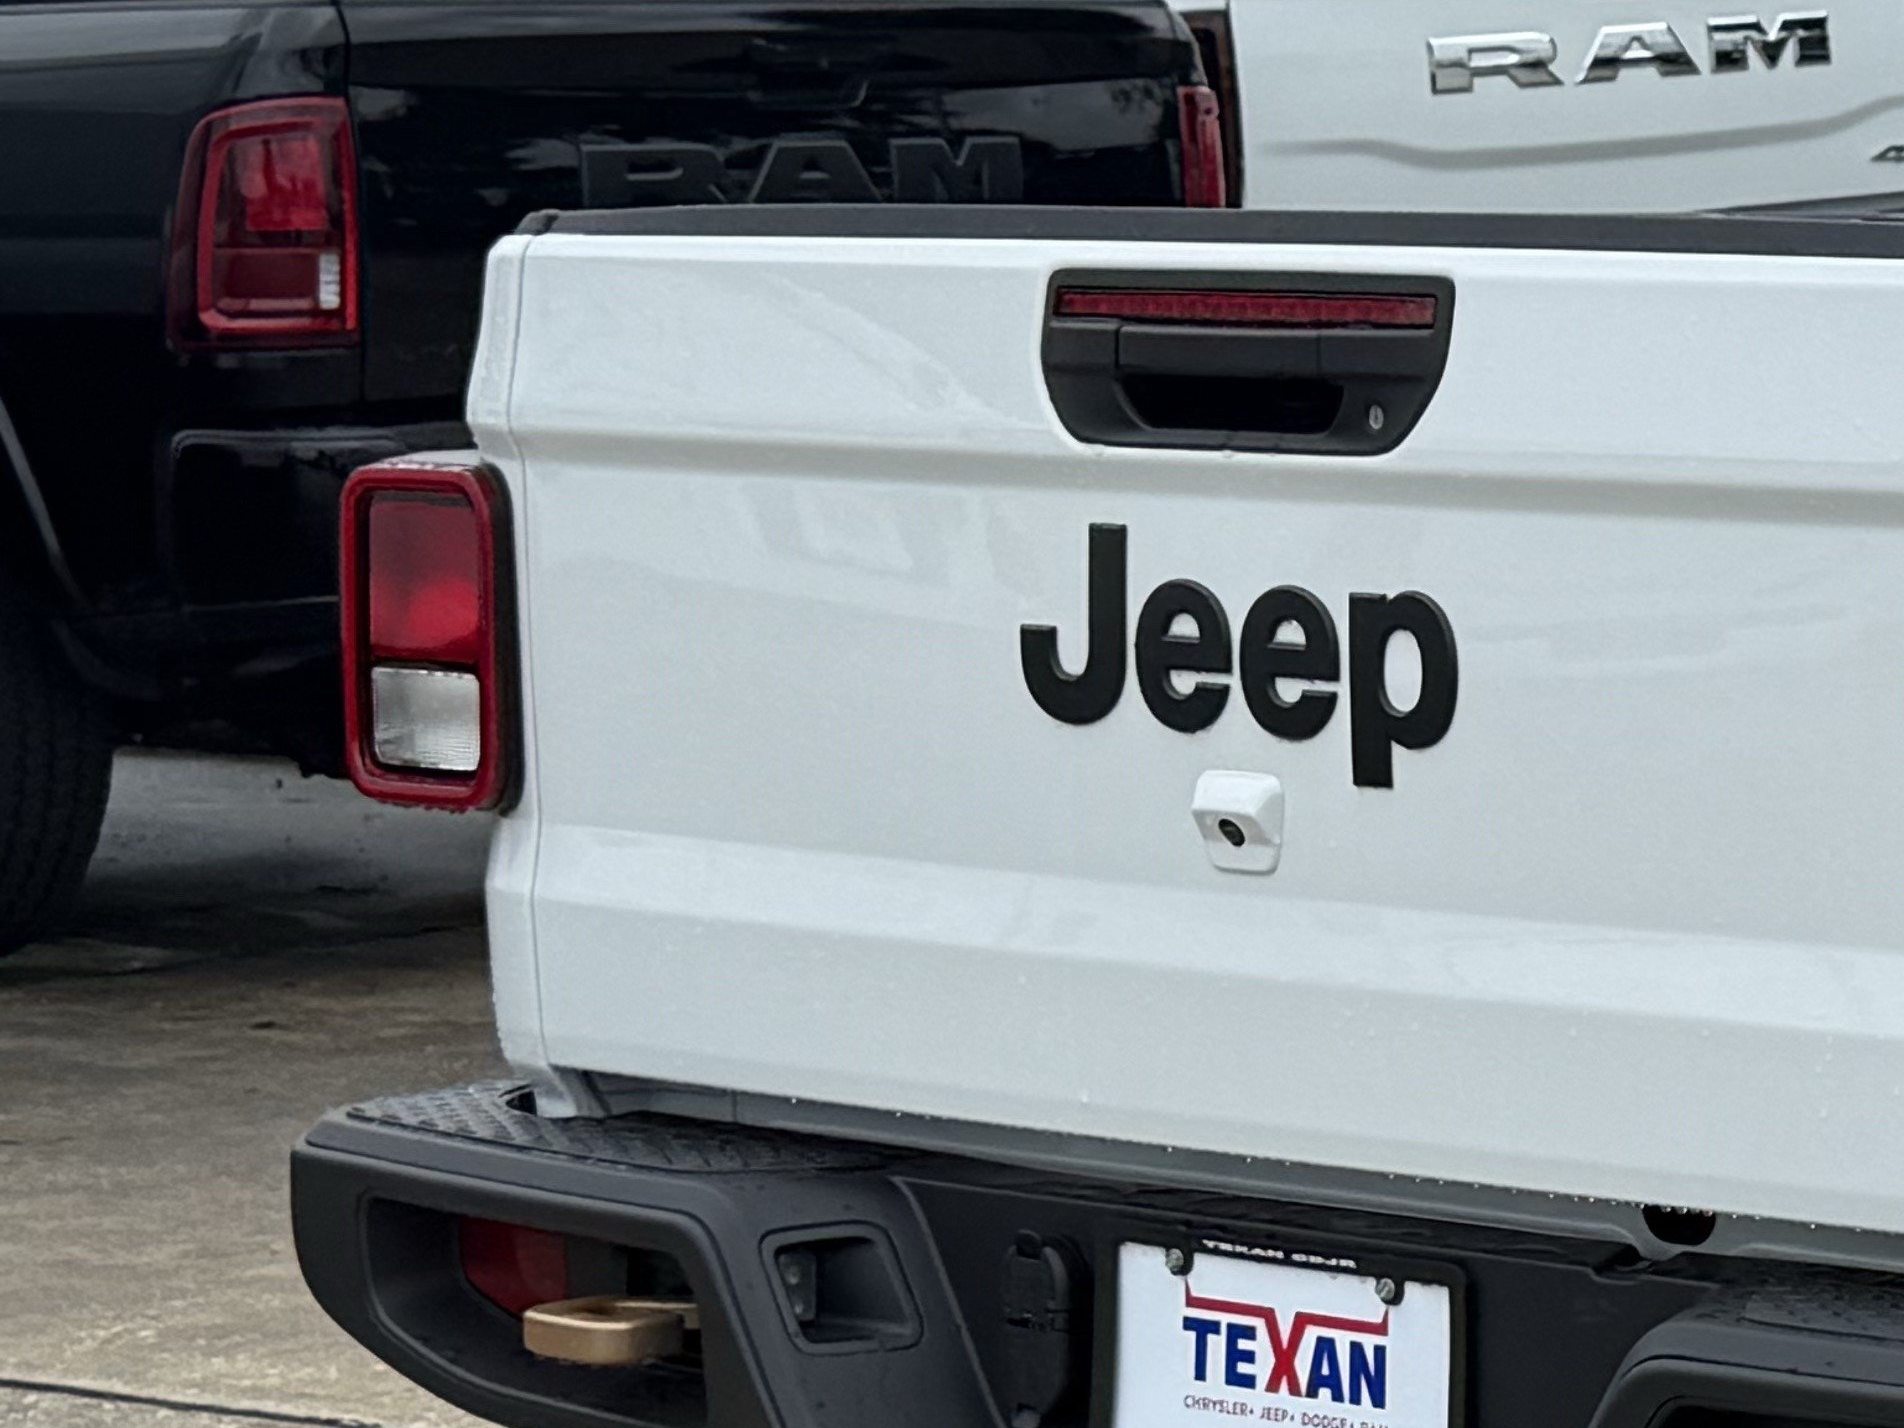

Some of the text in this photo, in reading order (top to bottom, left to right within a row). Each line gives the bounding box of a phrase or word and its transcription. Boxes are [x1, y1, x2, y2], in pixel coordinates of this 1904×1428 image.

[1427, 10, 1832, 95] RAM
[580, 135, 1024, 204] RAM
[1020, 523, 1459, 788] Jeep
[1182, 1294, 1388, 1410] TEXAN
[1184, 1394, 1249, 1416] CHRYSLER
[1259, 1406, 1288, 1423] JEEP
